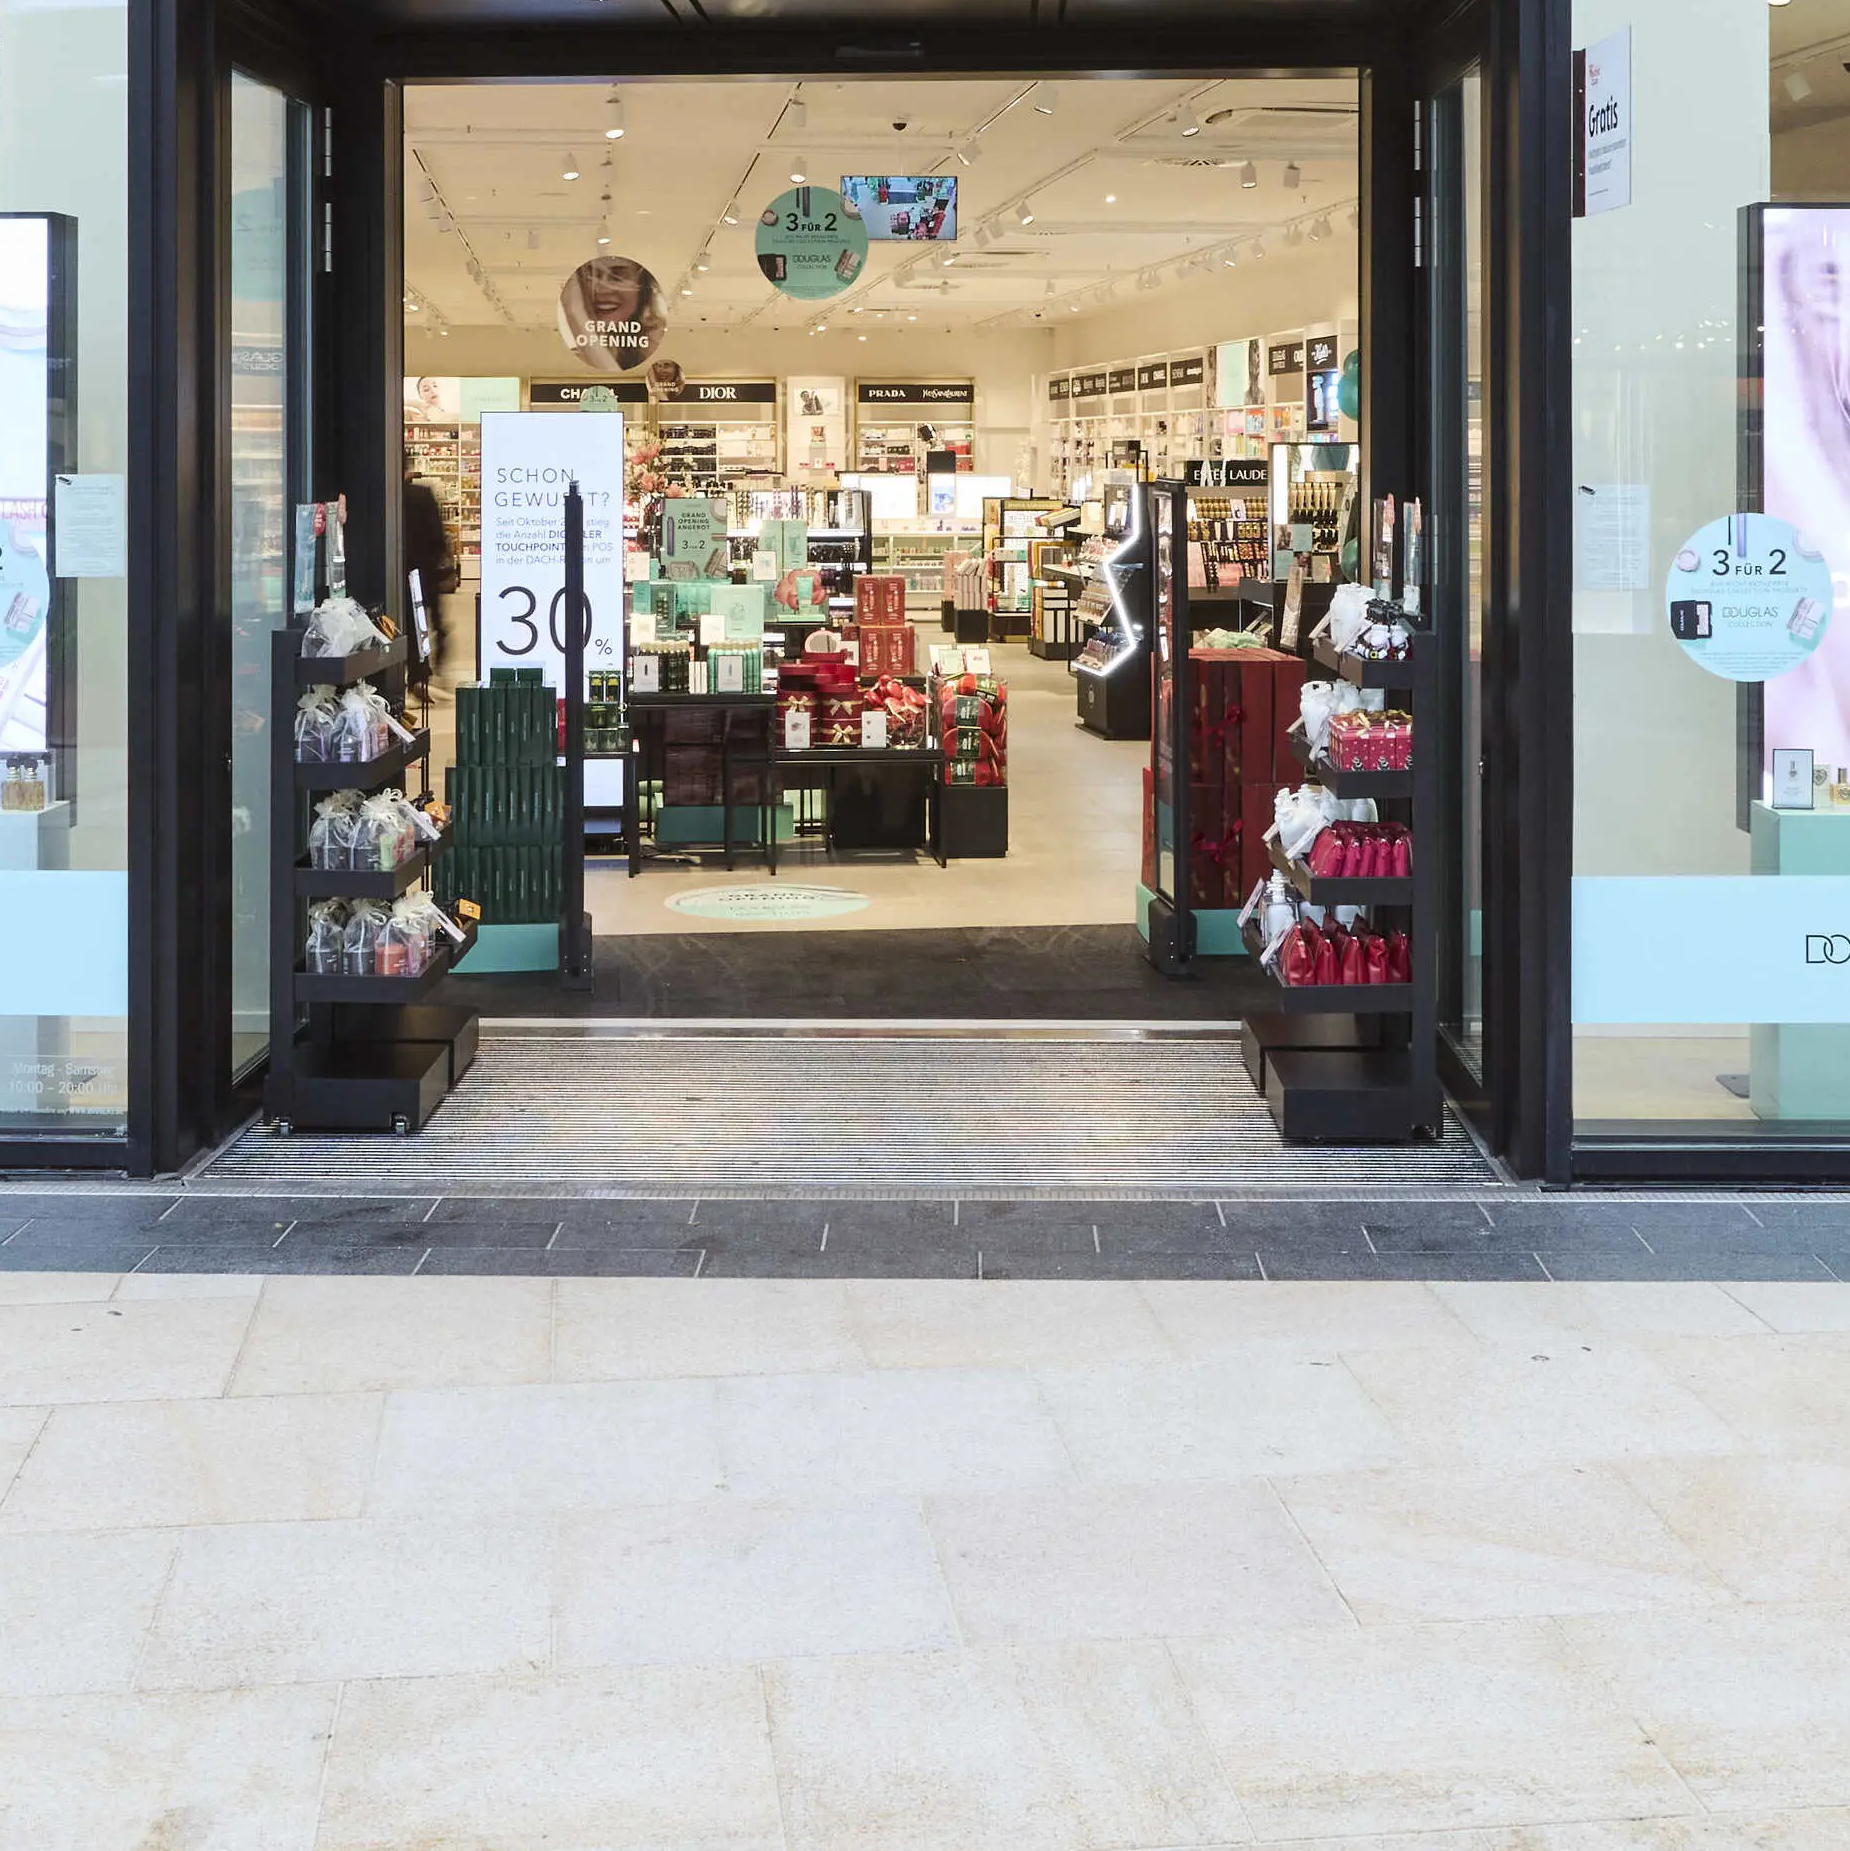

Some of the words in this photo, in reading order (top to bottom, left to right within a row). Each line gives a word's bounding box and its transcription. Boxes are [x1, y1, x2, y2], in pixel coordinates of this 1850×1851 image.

[1588, 94, 1619, 138] Gratis
[786, 212, 799, 232] 3
[824, 212, 838, 232] 2
[584, 319, 642, 334] GRAND
[575, 334, 650, 349] OPENING
[699, 386, 737, 400] DIOR
[868, 389, 907, 398] PRADA
[496, 467, 574, 484] SCHON
[494, 491, 611, 507] GEWUT?
[1712, 549, 1730, 576] 3
[1735, 563, 1763, 576] FÜR
[1769, 548, 1788, 575] 2
[1722, 605, 1779, 618] DOUGLAS
[495, 585, 593, 656] 30
[595, 638, 613, 655] %
[58, 1080, 94, 1094] 20:00
